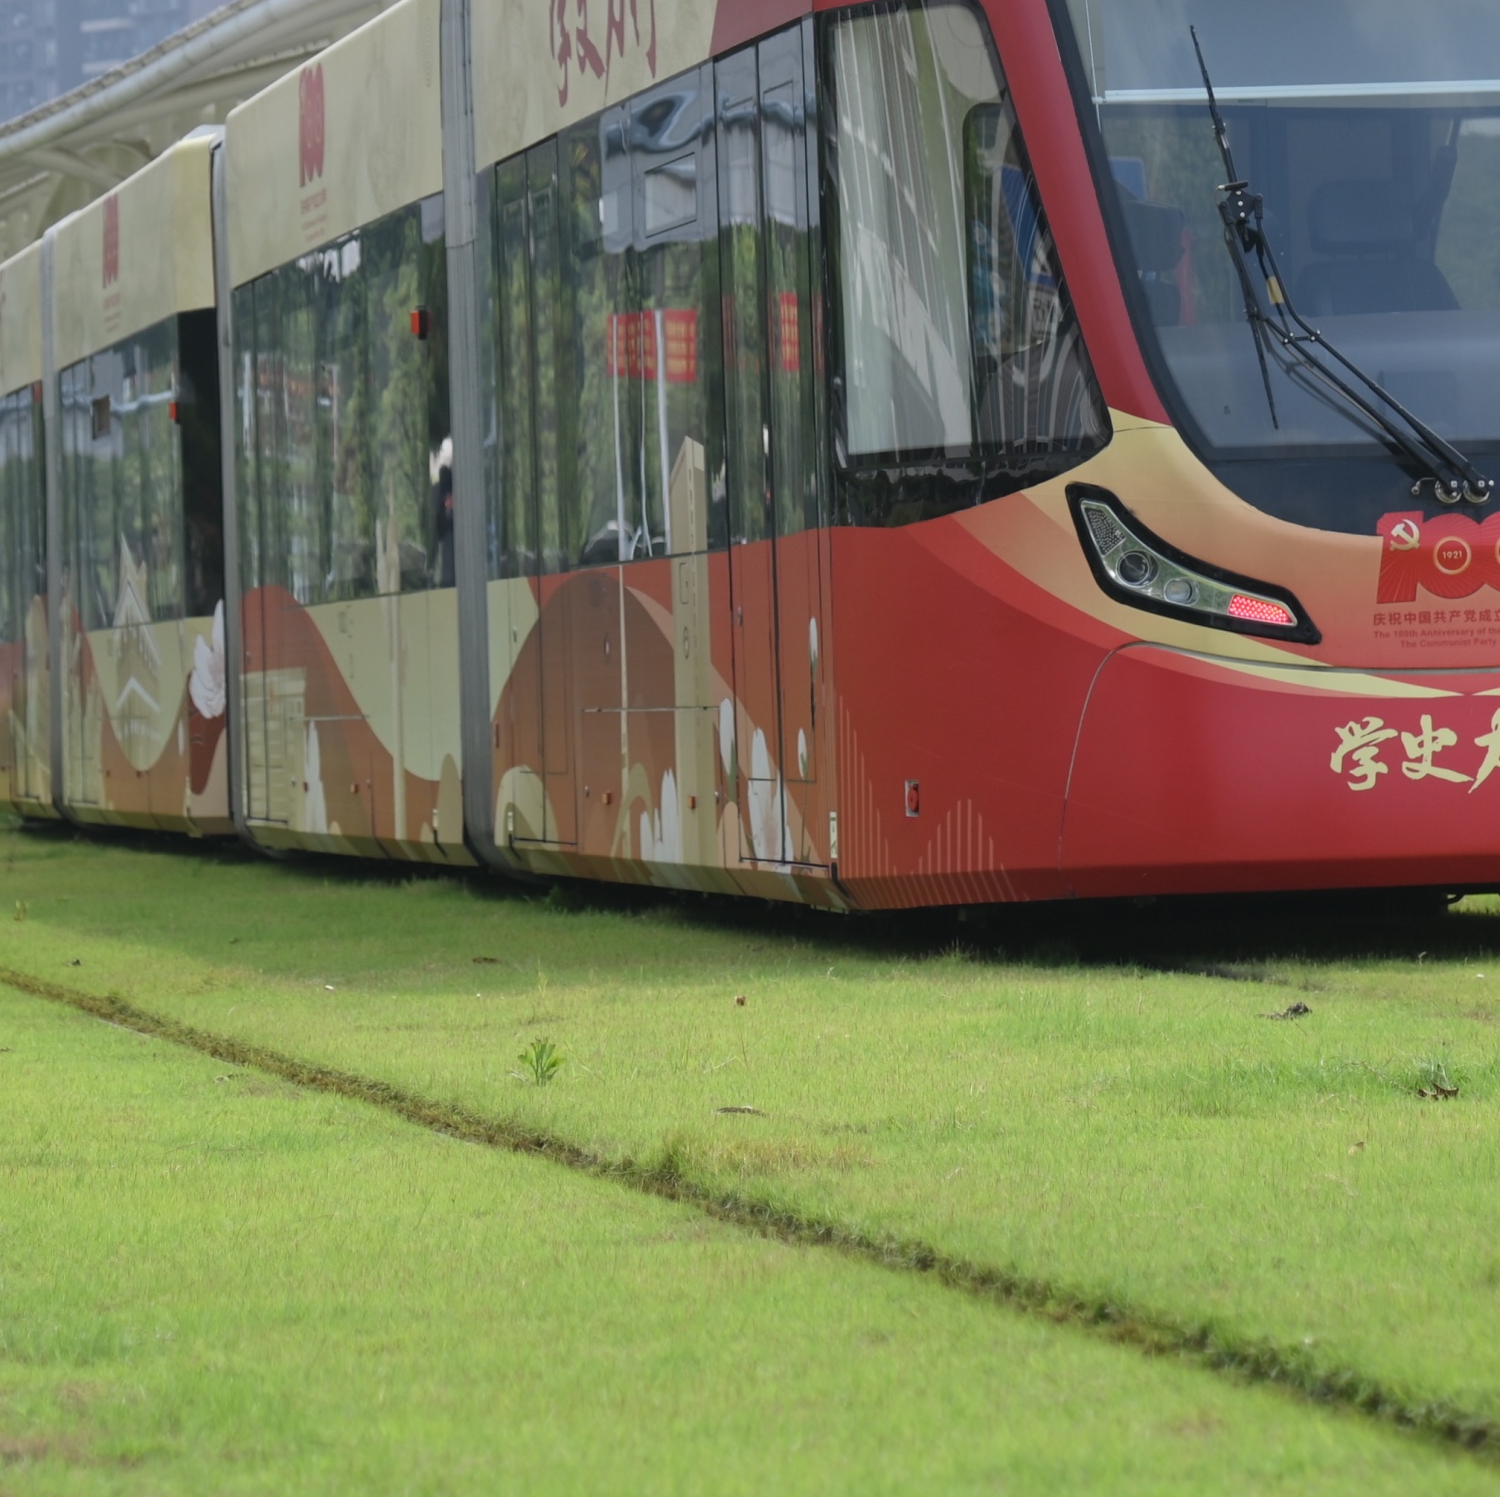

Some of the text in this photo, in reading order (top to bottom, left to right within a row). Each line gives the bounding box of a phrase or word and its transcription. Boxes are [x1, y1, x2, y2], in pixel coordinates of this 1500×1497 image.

[1442, 550, 1463, 560] 1921
[1374, 631, 1391, 639] The
[1393, 630, 1418, 639] 100th
[1420, 627, 1475, 638] Anniversary
[1477, 627, 1487, 636] of
[1401, 640, 1418, 649] The
[1420, 638, 1472, 648] Communist
[1474, 637, 1498, 648] Party
